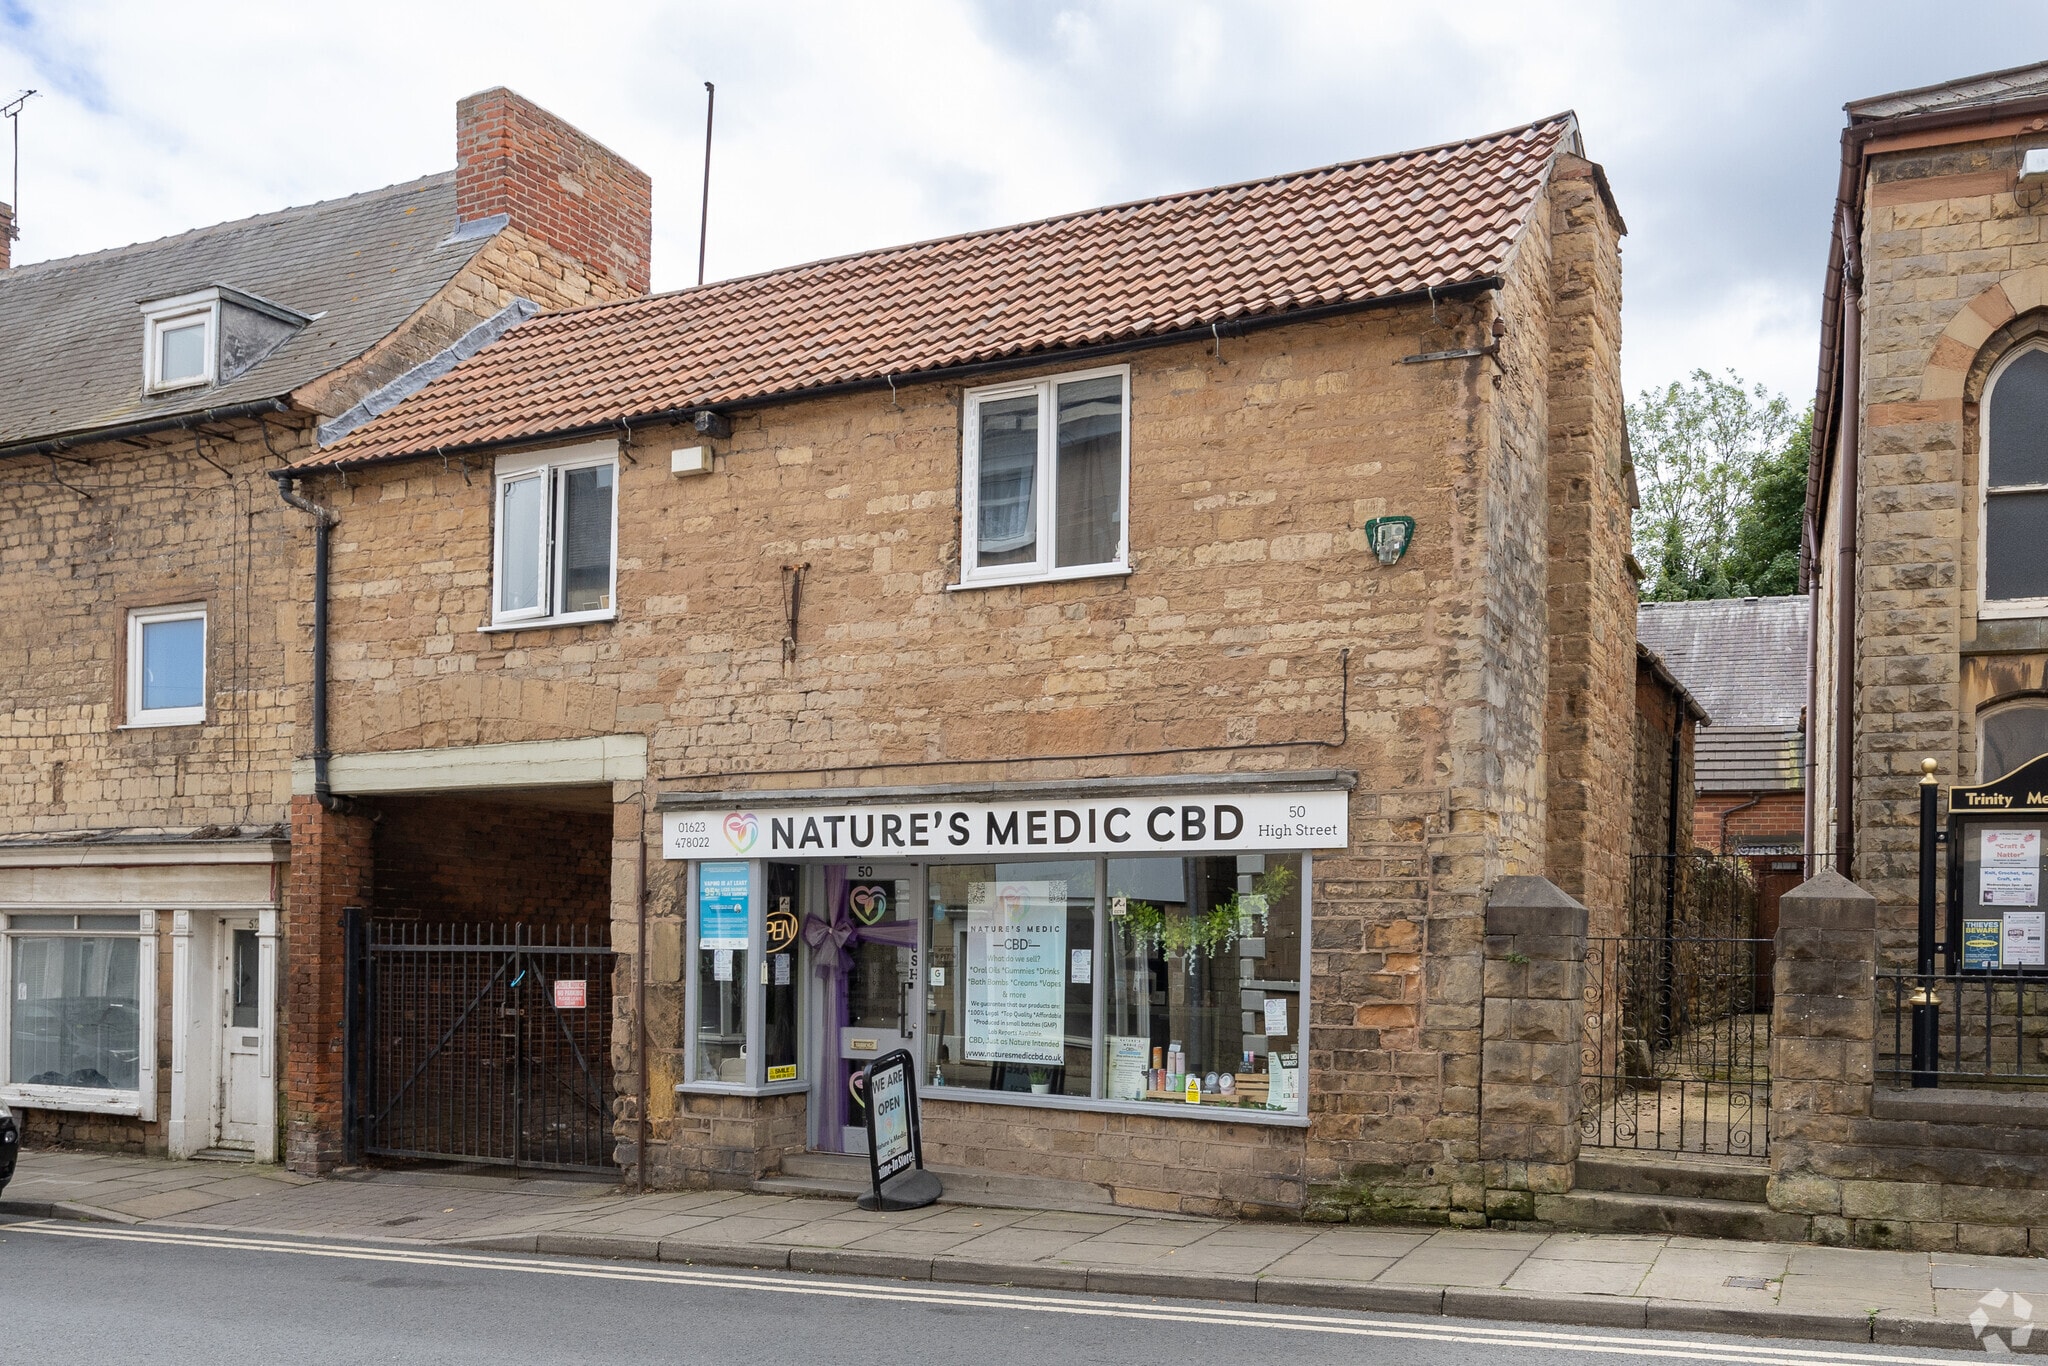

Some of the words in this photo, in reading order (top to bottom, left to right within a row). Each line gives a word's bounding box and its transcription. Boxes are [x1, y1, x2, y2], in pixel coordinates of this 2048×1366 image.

[1964, 792, 2013, 808] Trinity
[1288, 805, 1306, 818] 50
[678, 822, 706, 834] 01623
[771, 811, 970, 850] NATURE'S
[987, 806, 1132, 846] MEDIC
[1147, 804, 1244, 843] CBD
[1258, 823, 1292, 840] High
[1295, 823, 1338, 836] Street
[674, 836, 710, 849] 478022
[858, 866, 873, 878] 50
[970, 925, 1021, 933] NATURE'S
[1026, 925, 1060, 933] MEDIC
[1004, 938, 1028, 951] CBD
[988, 954, 1004, 962] What
[1026, 955, 1041, 963] sell?
[1008, 1038, 1031, 1047] Nature
[1031, 1039, 1060, 1048] Intended
[965, 1050, 1062, 1061] www.naturesmediccbd.co.uk
[872, 1076, 885, 1094] WE
[887, 1069, 903, 1088] ARE
[877, 1094, 900, 1116] OPEN
